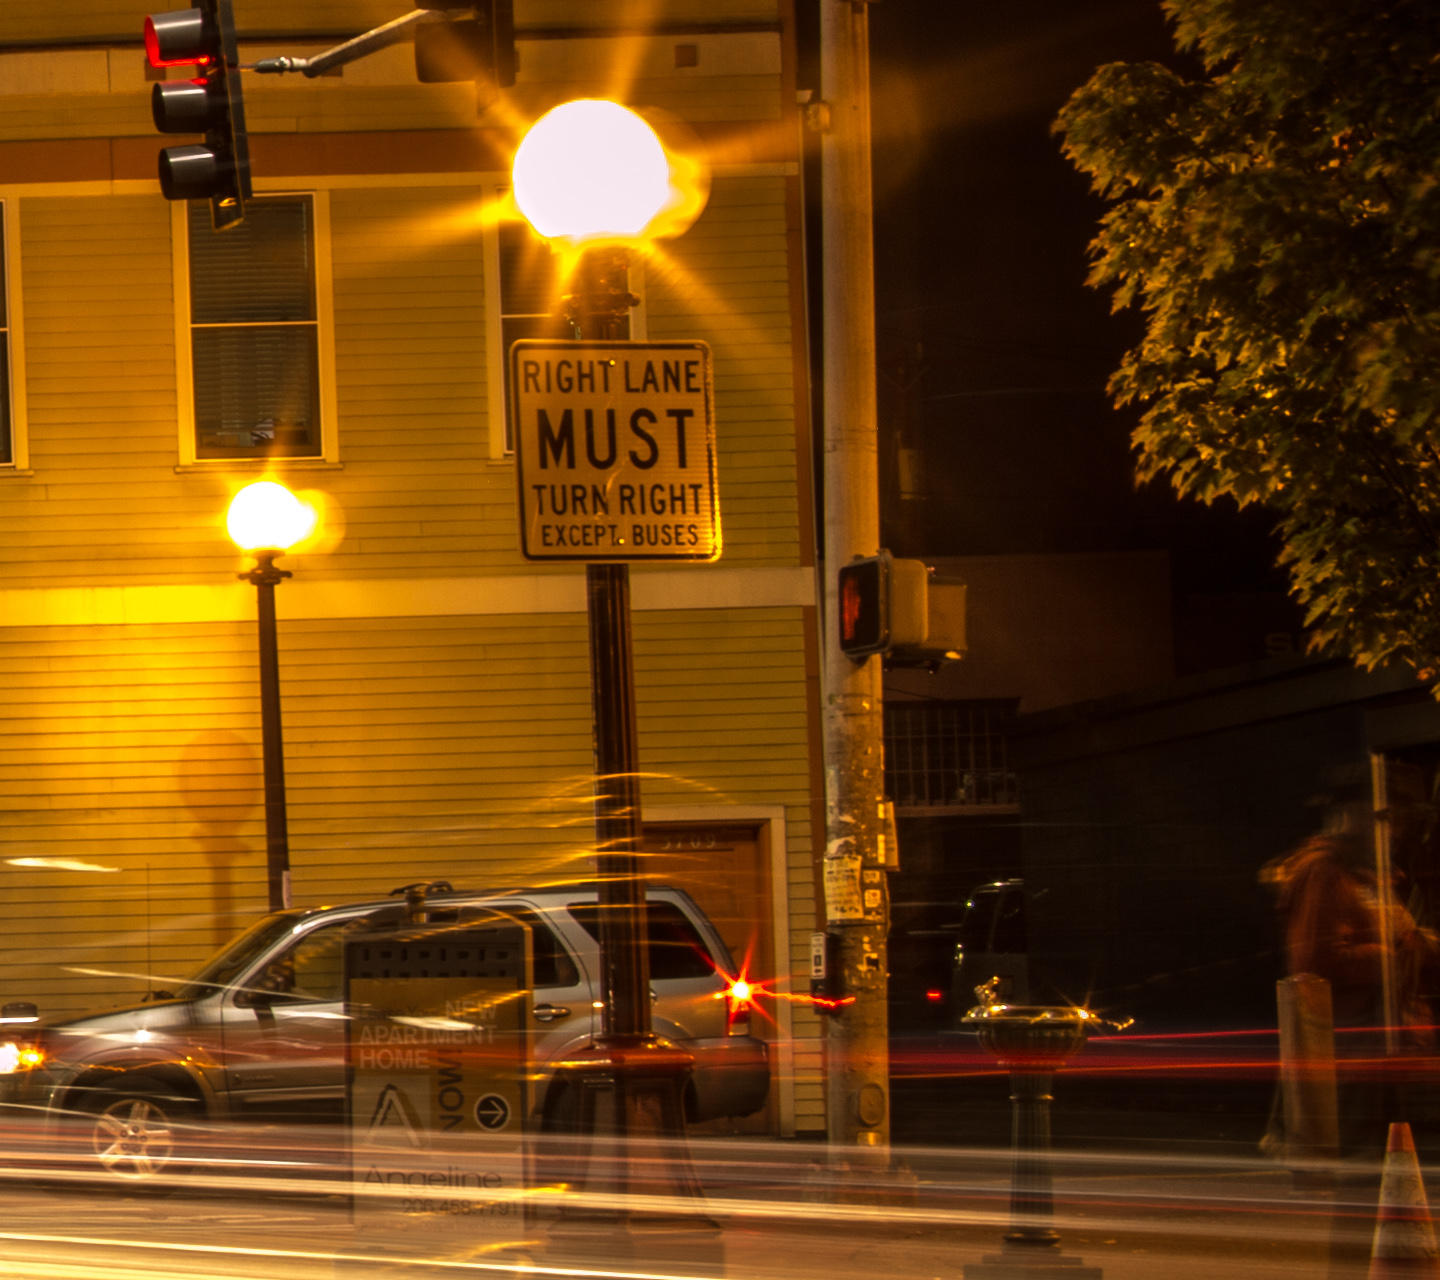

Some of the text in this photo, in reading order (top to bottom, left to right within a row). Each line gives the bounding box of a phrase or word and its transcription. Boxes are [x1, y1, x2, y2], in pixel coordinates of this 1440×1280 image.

[523, 360, 701, 394] RIGHT LANE
[536, 408, 695, 470] MUST
[532, 484, 703, 516] TURN RIGHT
[541, 524, 699, 547] EXCEPT BUSES
[445, 999, 498, 1020] NEW
[359, 1024, 497, 1045] APARTMENT
[359, 1048, 430, 1070] HOME
[362, 1164, 502, 1193] Angeline
